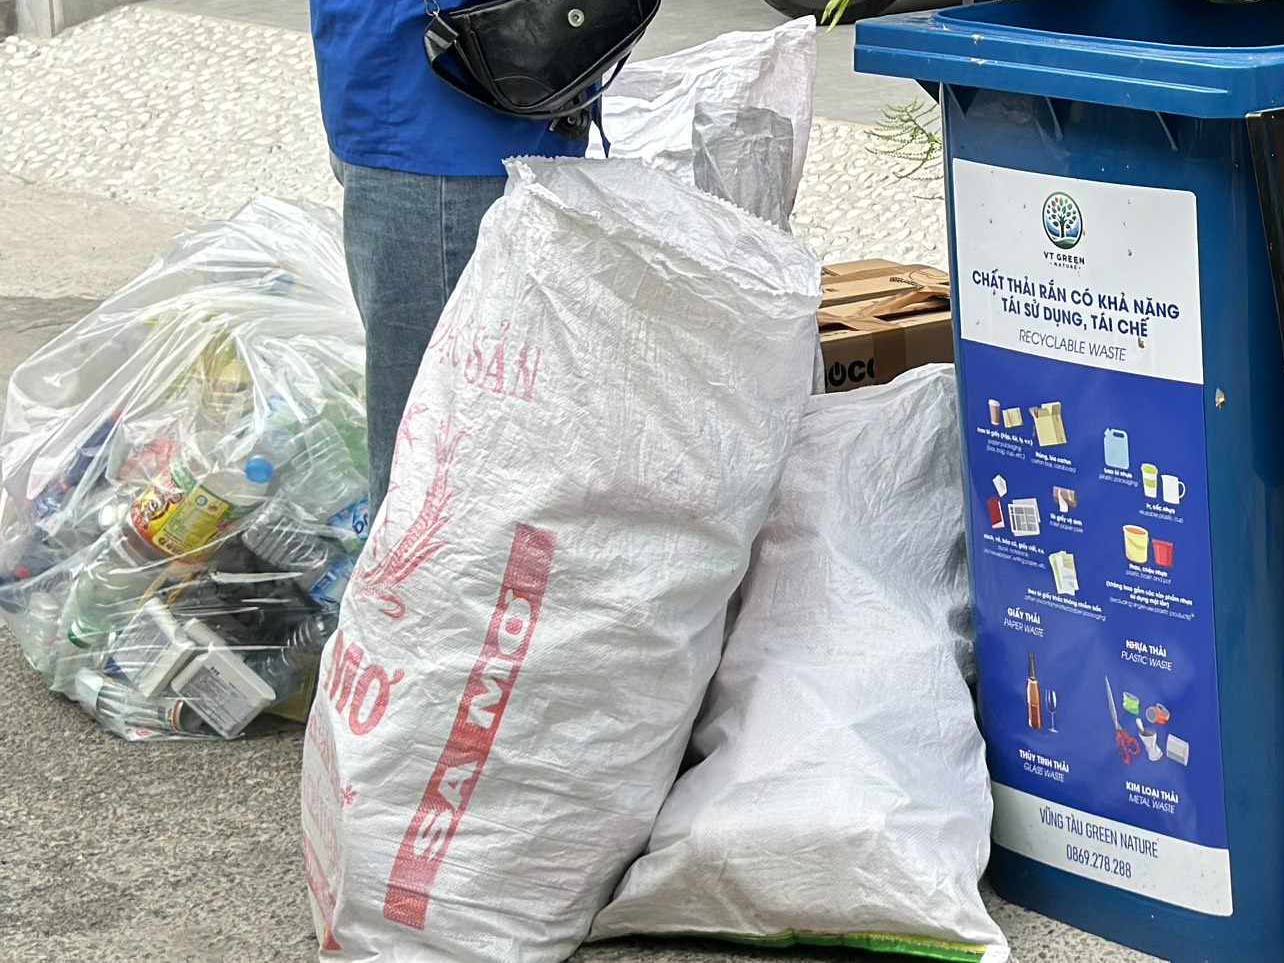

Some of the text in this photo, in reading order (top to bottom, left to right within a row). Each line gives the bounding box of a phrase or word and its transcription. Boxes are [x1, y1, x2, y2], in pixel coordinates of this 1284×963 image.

[1044, 251, 1085, 265] VT GREEN
[972, 268, 1180, 320] CHẤT THẢI RẮN CÓ KHẢ NĂNG
[1002, 296, 1149, 337] TÁI SỬ DỤNG, TÁI CHẾ
[1020, 328, 1126, 362] RECYCLABLE WASTE
[1008, 608, 1024, 620] GIẤY
[1025, 612, 1041, 625] THẢI
[1004, 618, 1044, 638] PAPER WASTE
[1126, 639, 1166, 658] NHỰA THẢI
[1121, 650, 1172, 671] PLASTIC WASTE
[1024, 762, 1065, 783] GLASS WASTE
[1037, 754, 1053, 768] TINH
[1054, 758, 1070, 772] THẢI
[1126, 780, 1178, 803] KIM LOẠI THẢI
[1129, 793, 1176, 814] METAL WASTE
[1040, 806, 1159, 858] VŨNG TÀU GREEN NATURE
[1066, 844, 1132, 878] 0869.278.288
